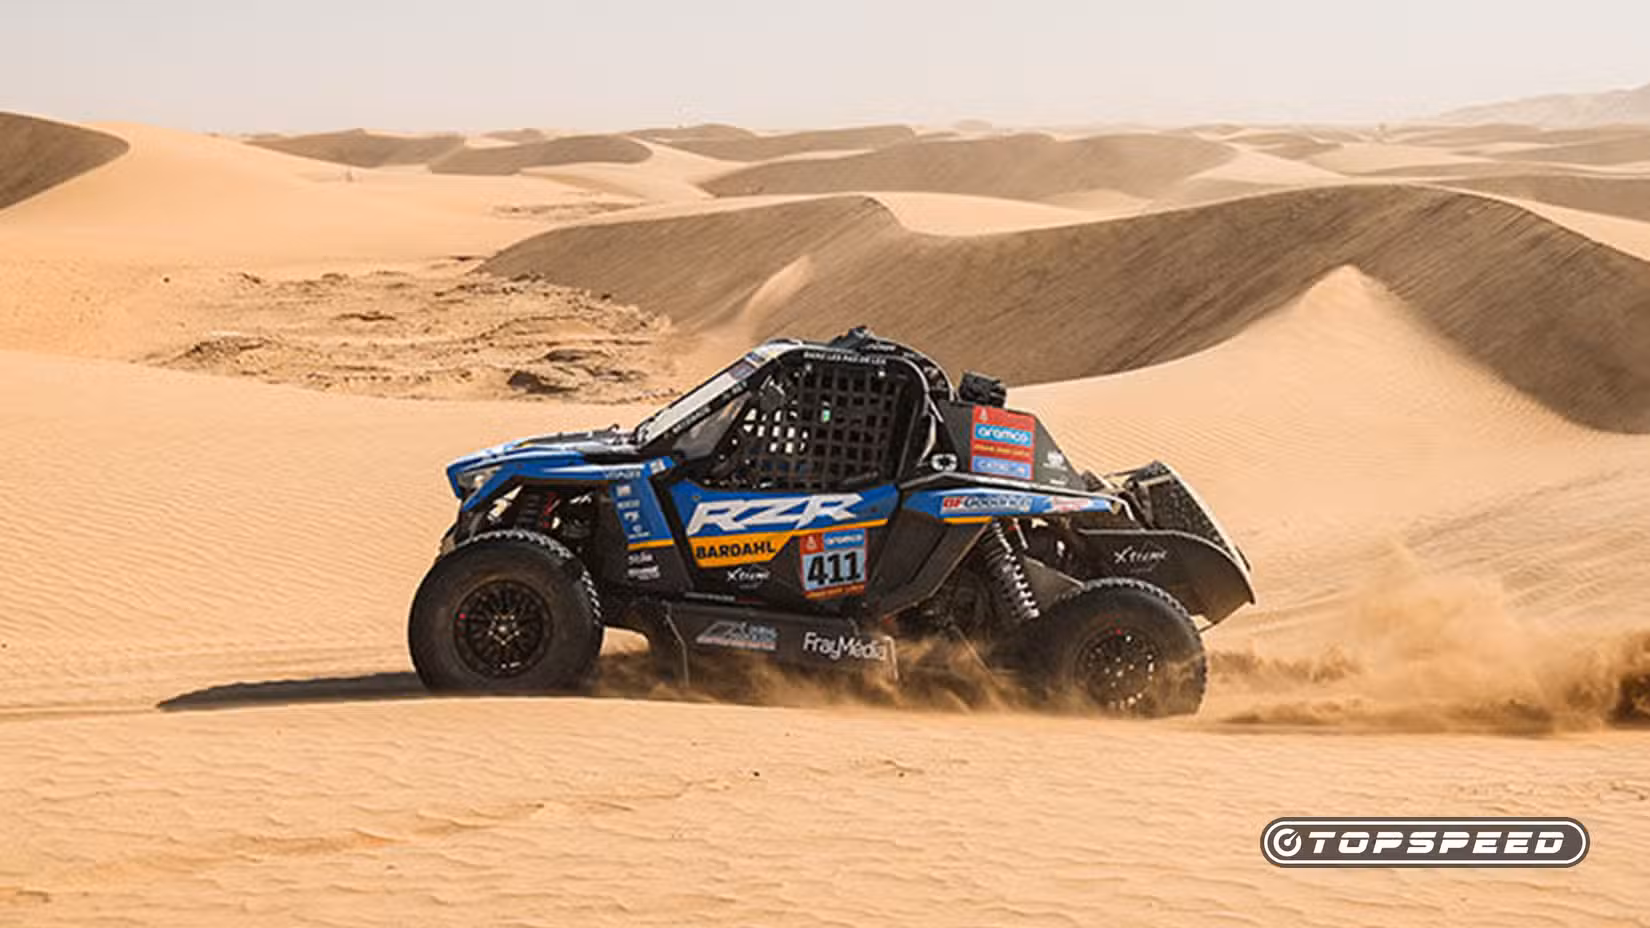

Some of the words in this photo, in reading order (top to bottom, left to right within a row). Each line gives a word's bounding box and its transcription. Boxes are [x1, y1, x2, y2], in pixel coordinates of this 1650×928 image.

[978, 425, 1029, 441] aramco
[686, 493, 864, 536] RZR
[696, 541, 778, 560] BARDAHL
[807, 552, 861, 586] 411
[803, 631, 888, 661] FrayMédia
